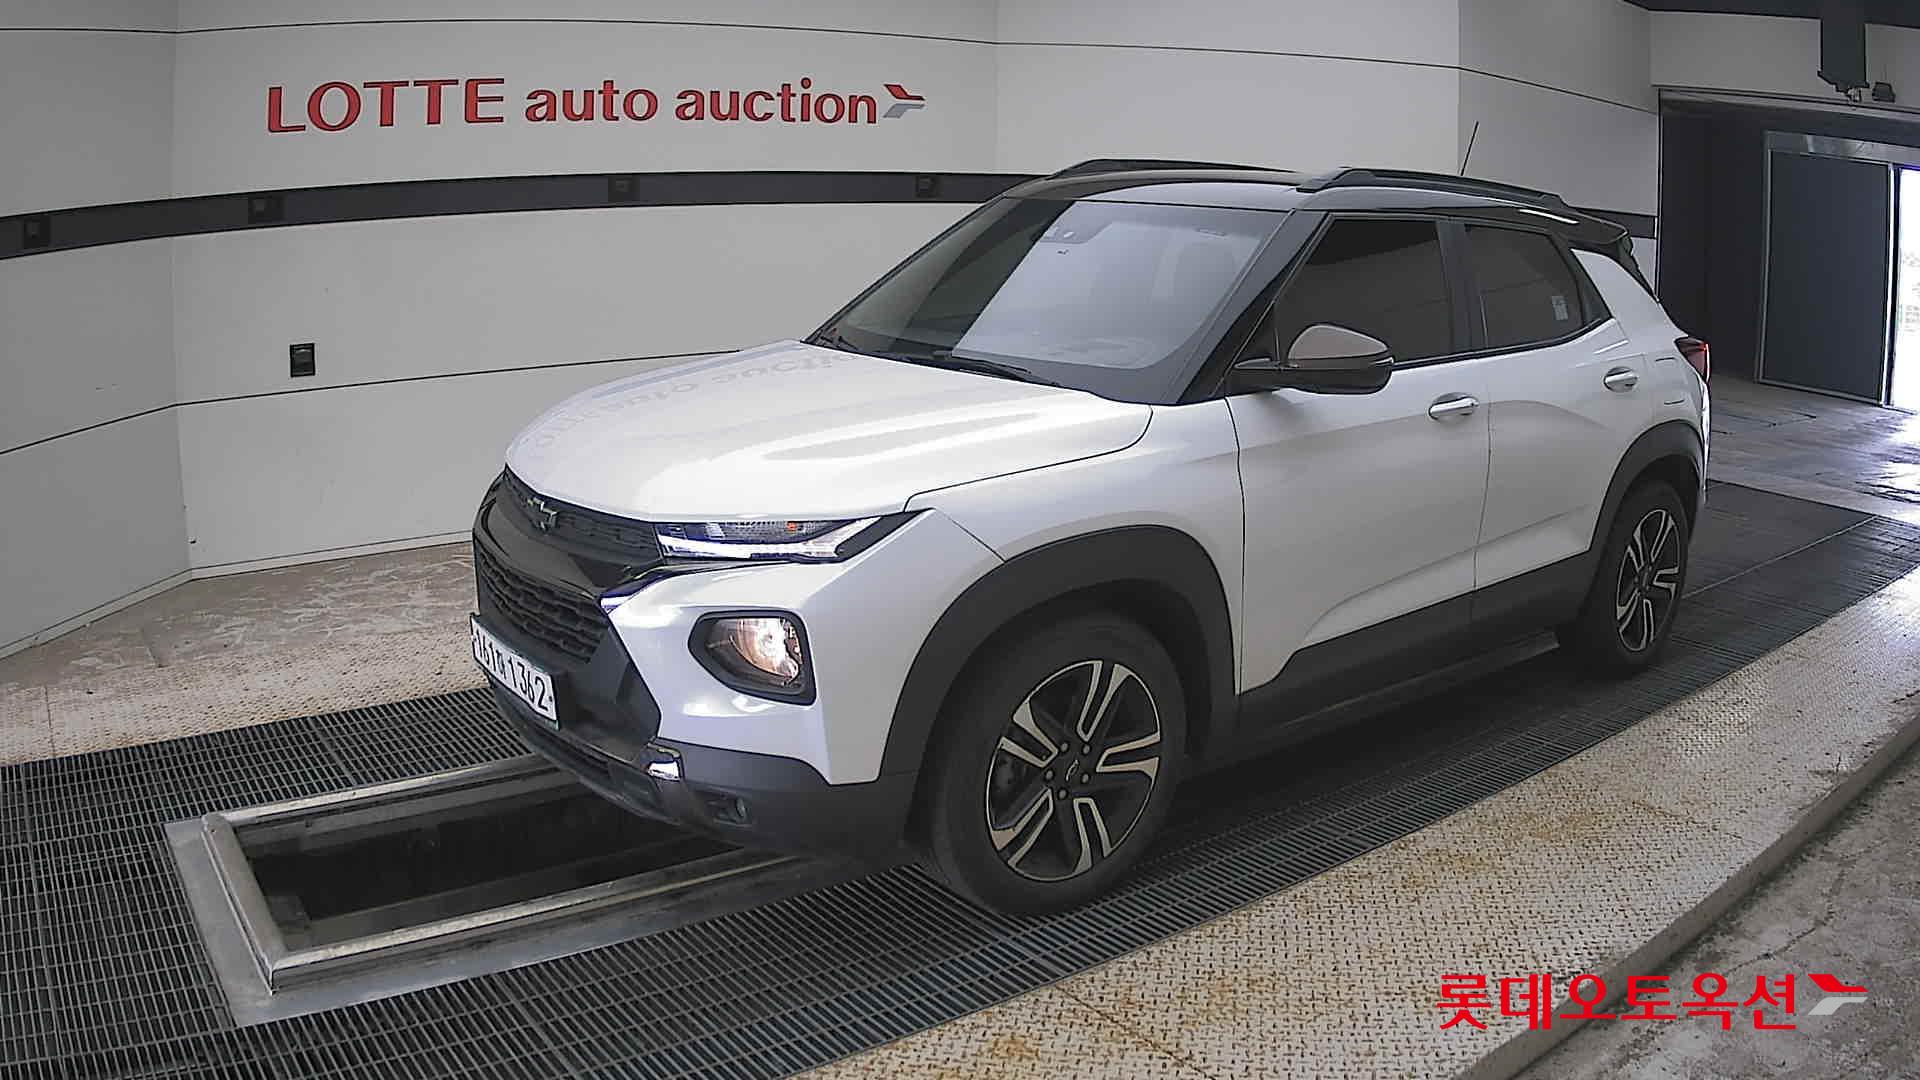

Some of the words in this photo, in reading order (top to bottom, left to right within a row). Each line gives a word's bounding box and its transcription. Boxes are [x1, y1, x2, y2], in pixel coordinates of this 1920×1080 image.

[268, 78, 504, 132] LOTTE
[525, 80, 658, 122] auto
[675, 78, 878, 124] auction
